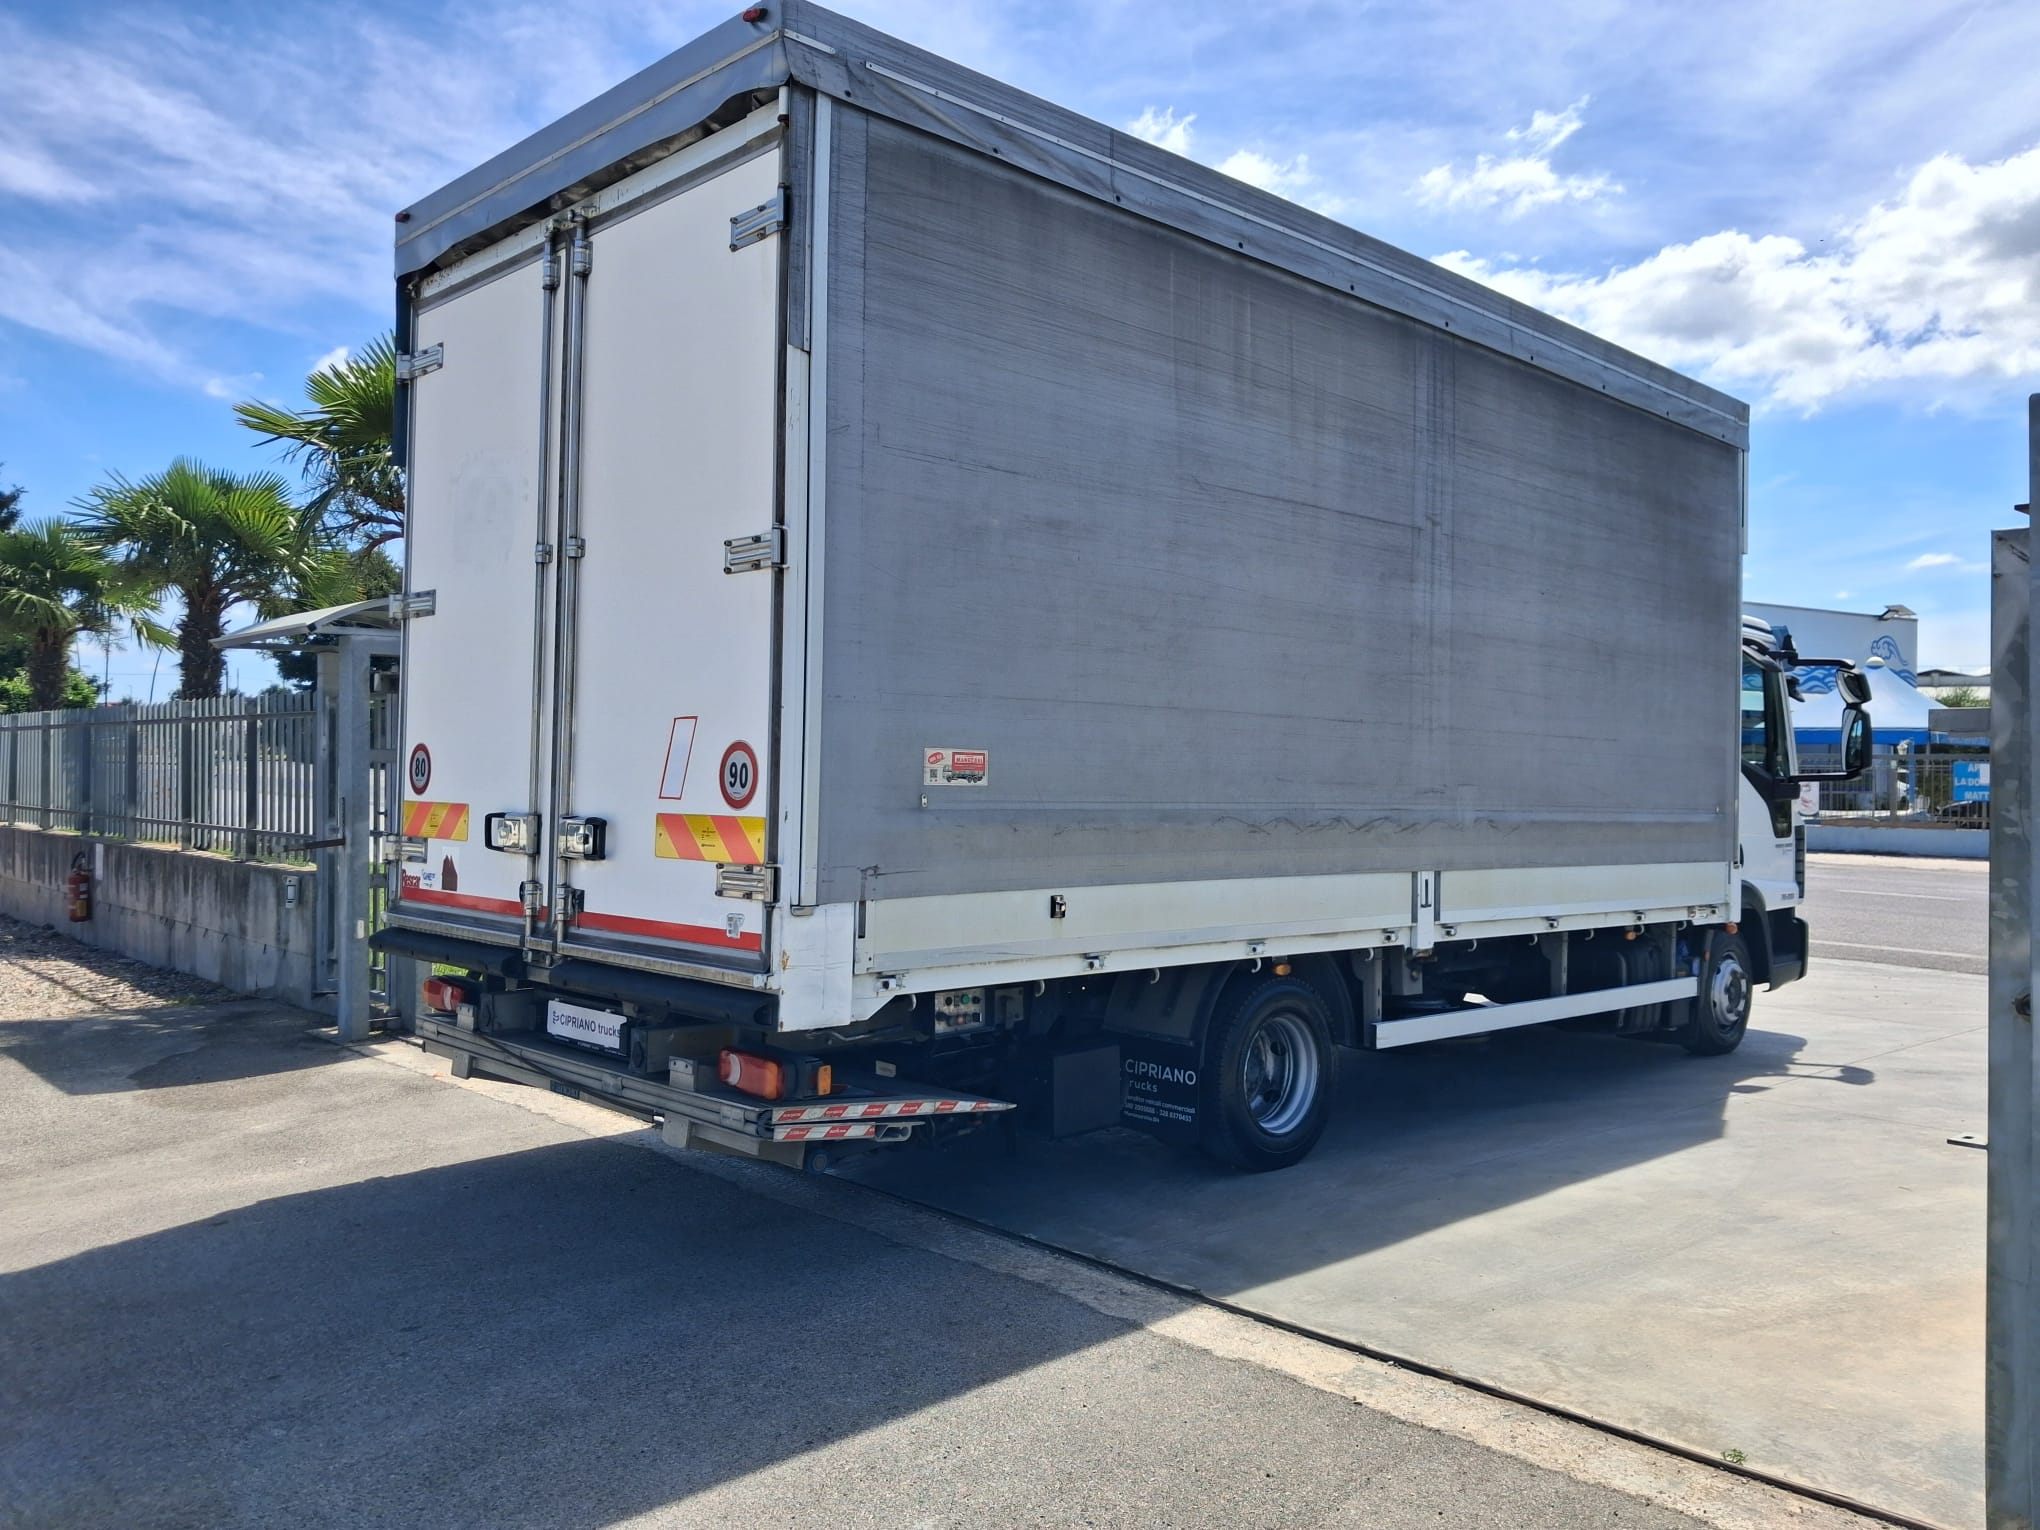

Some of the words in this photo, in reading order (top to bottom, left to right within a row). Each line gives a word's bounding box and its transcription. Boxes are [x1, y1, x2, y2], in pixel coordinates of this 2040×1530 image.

[415, 757, 426, 777] 80
[729, 761, 748, 788] 90
[1964, 791, 1990, 801] MATT
[560, 1014, 597, 1032] CIPRIANO
[598, 1023, 621, 1037] trucks
[1125, 1058, 1197, 1085] CIPRIANO
[1129, 1079, 1158, 1092] rucks
